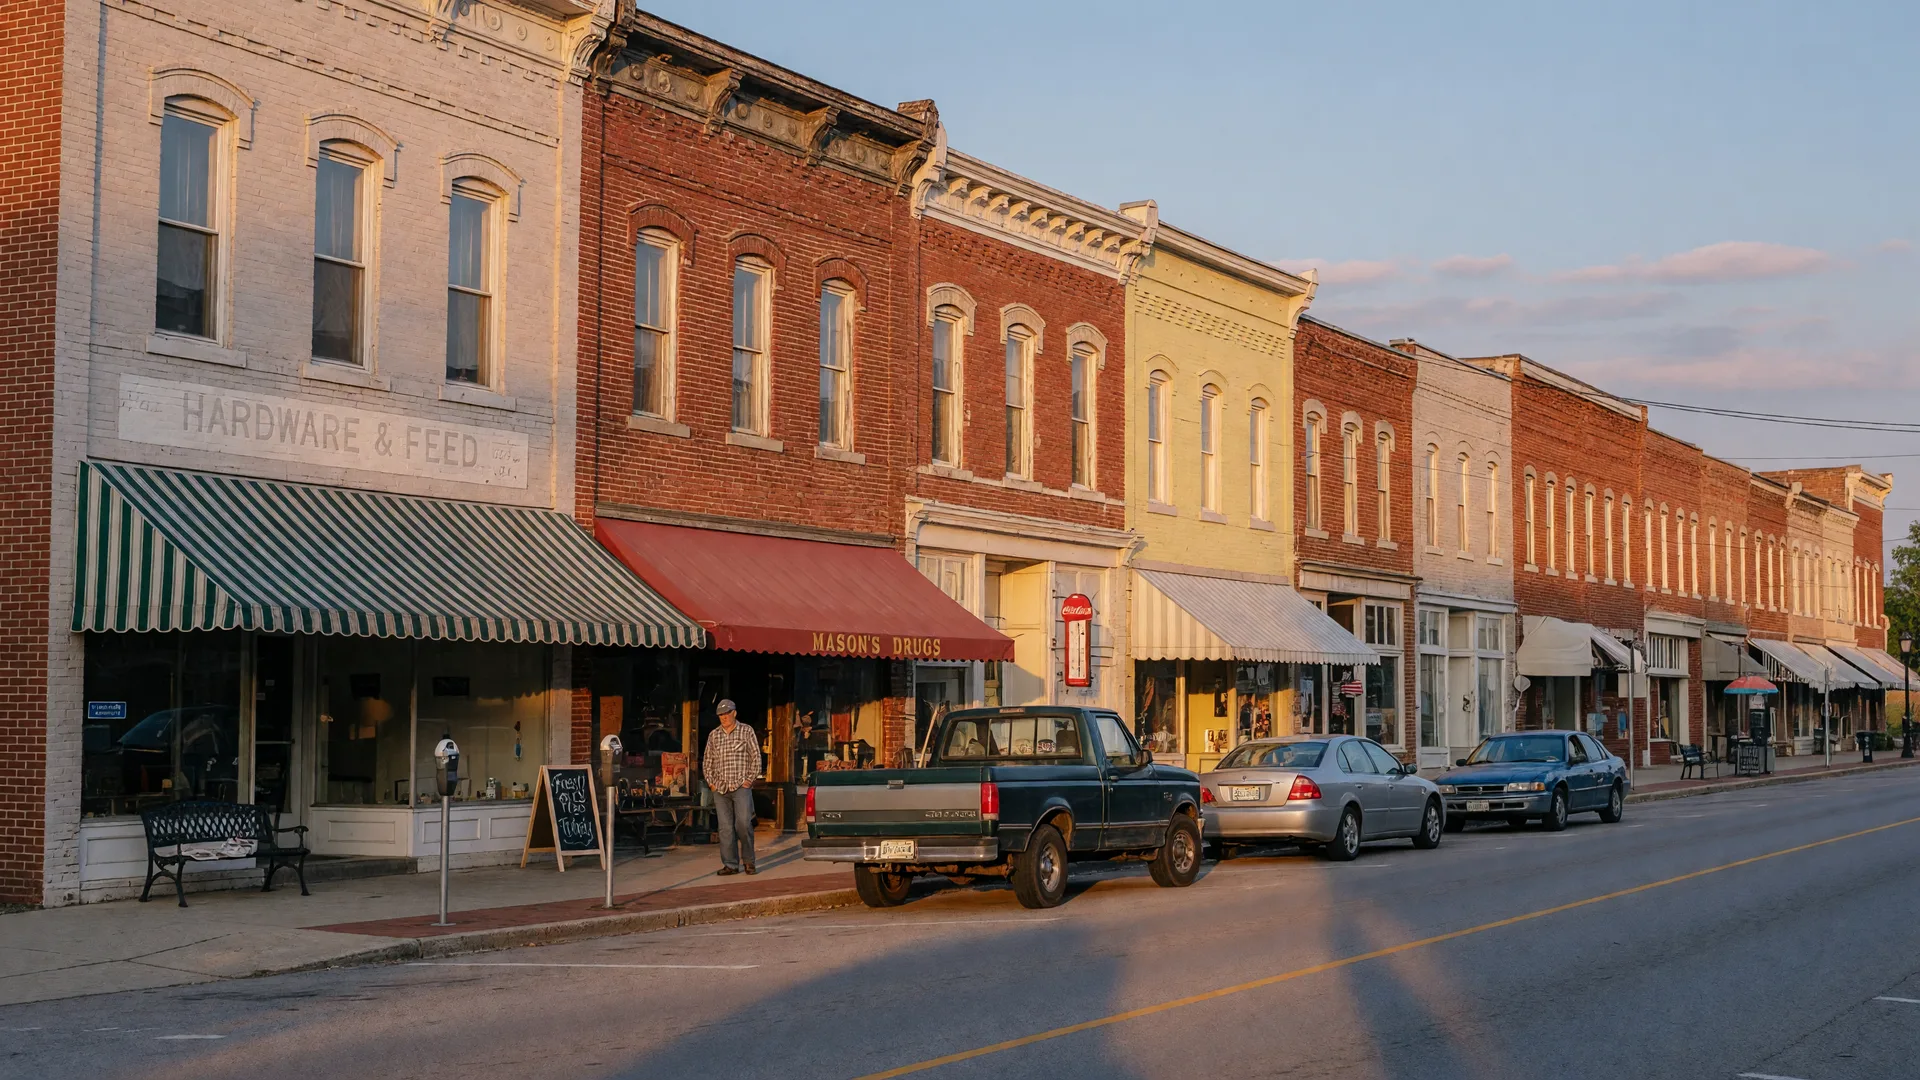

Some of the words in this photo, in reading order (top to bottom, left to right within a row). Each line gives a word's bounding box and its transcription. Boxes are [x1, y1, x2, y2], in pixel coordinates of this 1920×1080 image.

[182, 392, 361, 454] HARDWARE
[374, 421, 393, 458] &
[405, 426, 478, 468] FEED
[812, 632, 881, 655] MASON'S
[893, 637, 941, 657] DRUGS
